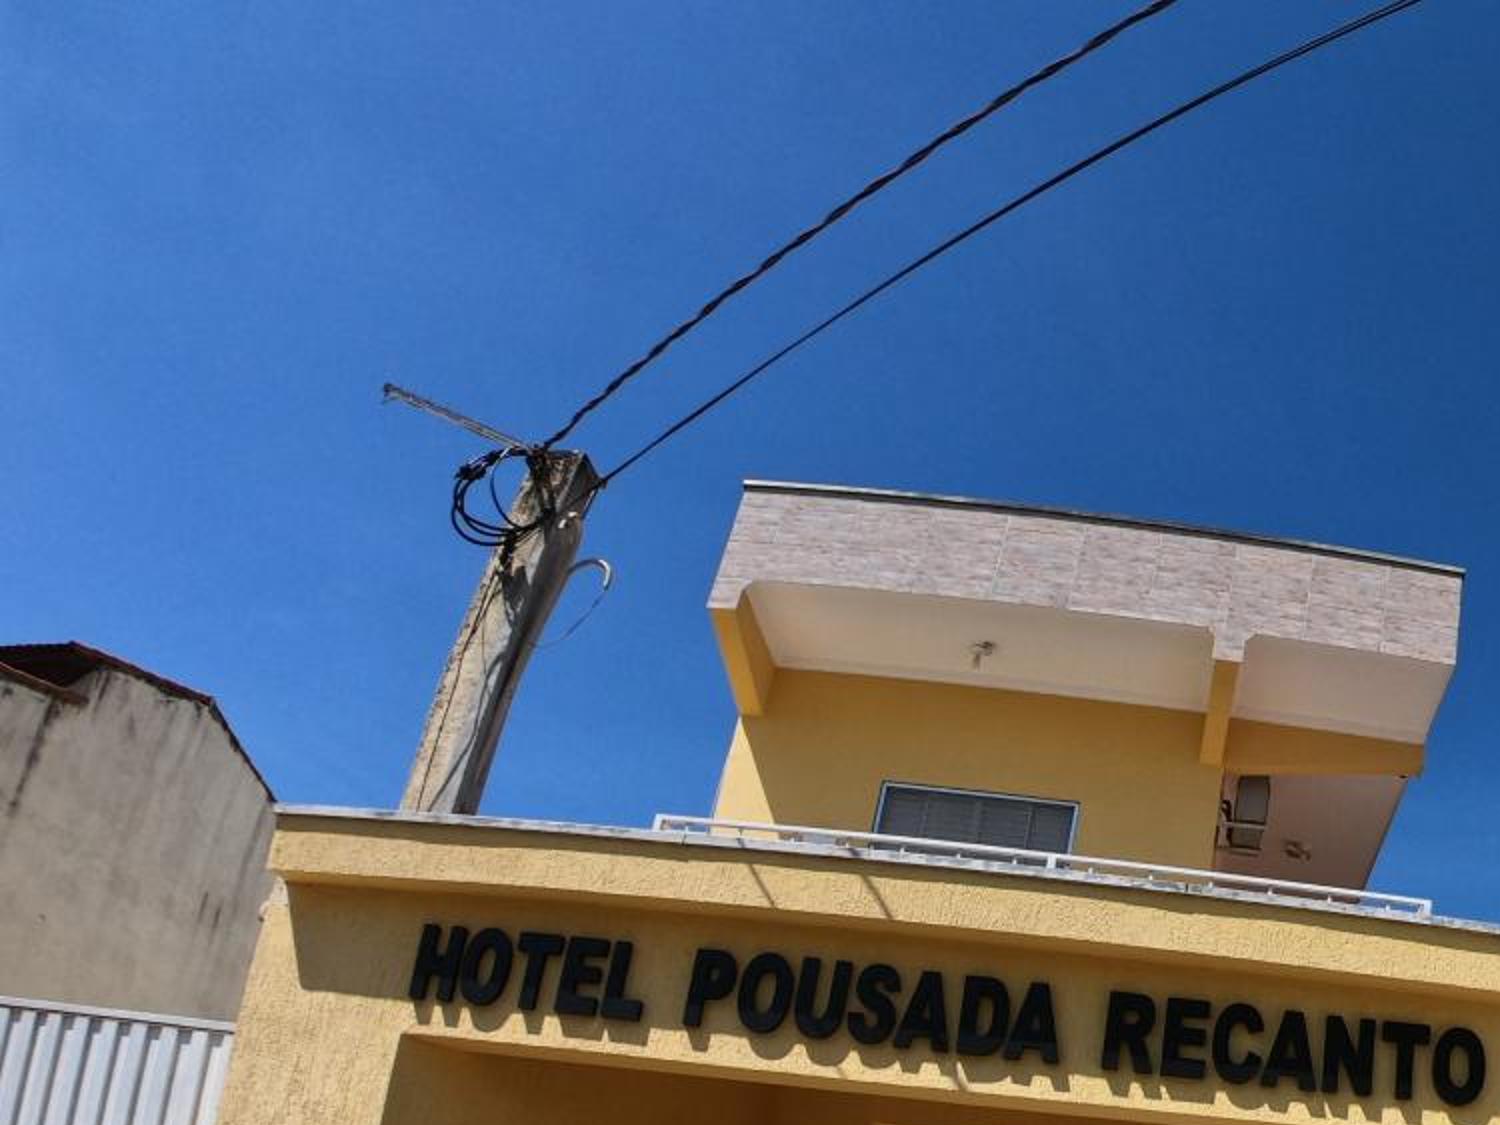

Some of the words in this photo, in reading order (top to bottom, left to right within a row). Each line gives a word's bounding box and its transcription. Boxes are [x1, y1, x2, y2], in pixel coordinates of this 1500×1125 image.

[409, 923, 644, 1022] HOTEL
[683, 948, 1060, 1065] POUSADA
[1101, 990, 1487, 1107] RECANTO
